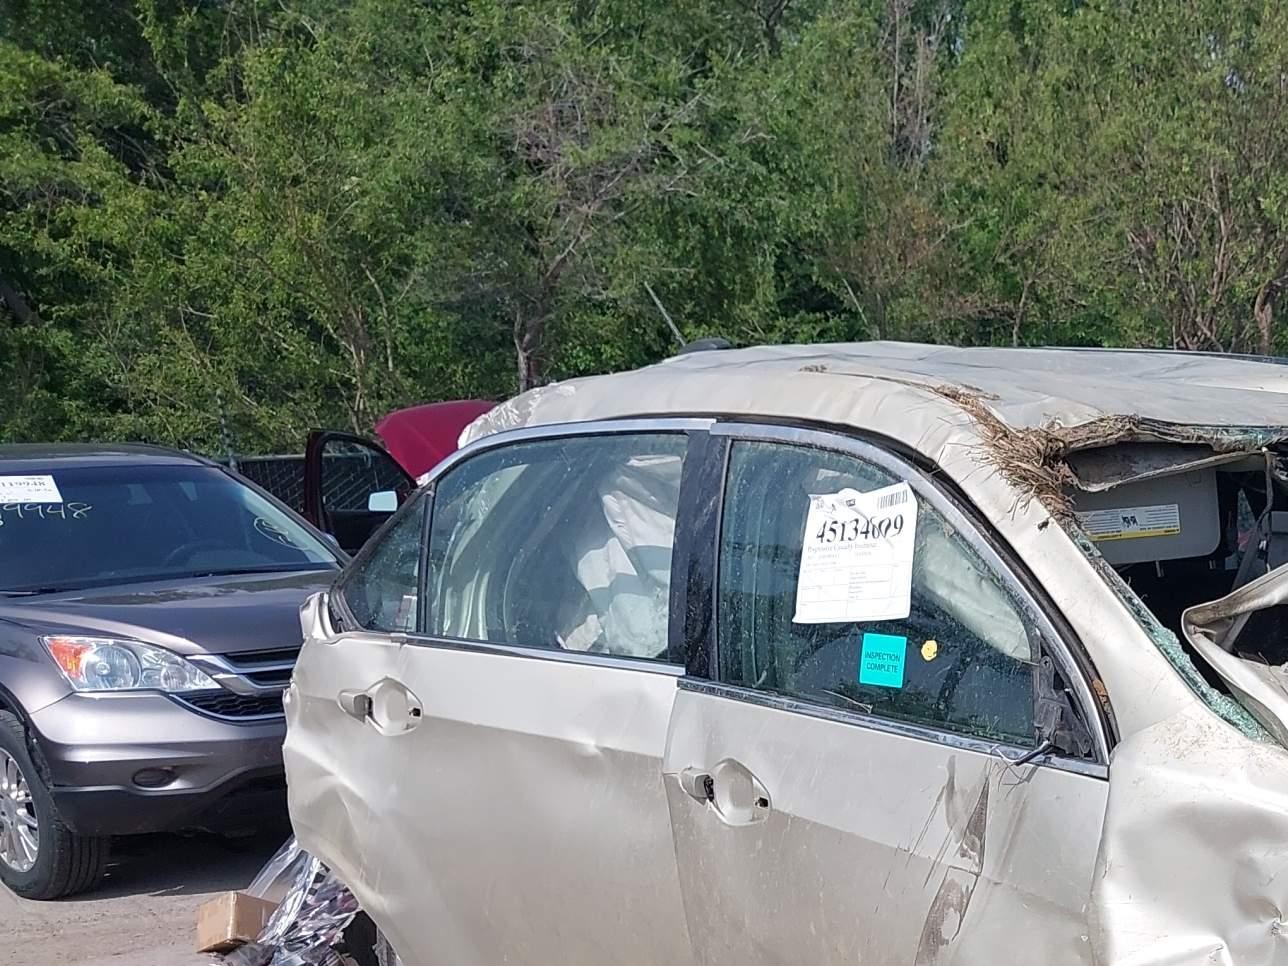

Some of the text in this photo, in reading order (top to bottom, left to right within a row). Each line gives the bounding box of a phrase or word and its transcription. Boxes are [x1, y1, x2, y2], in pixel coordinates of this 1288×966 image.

[816, 514, 904, 543] 45134609
[864, 651, 901, 662] INSPECTION
[866, 662, 899, 673] COMPLETE
